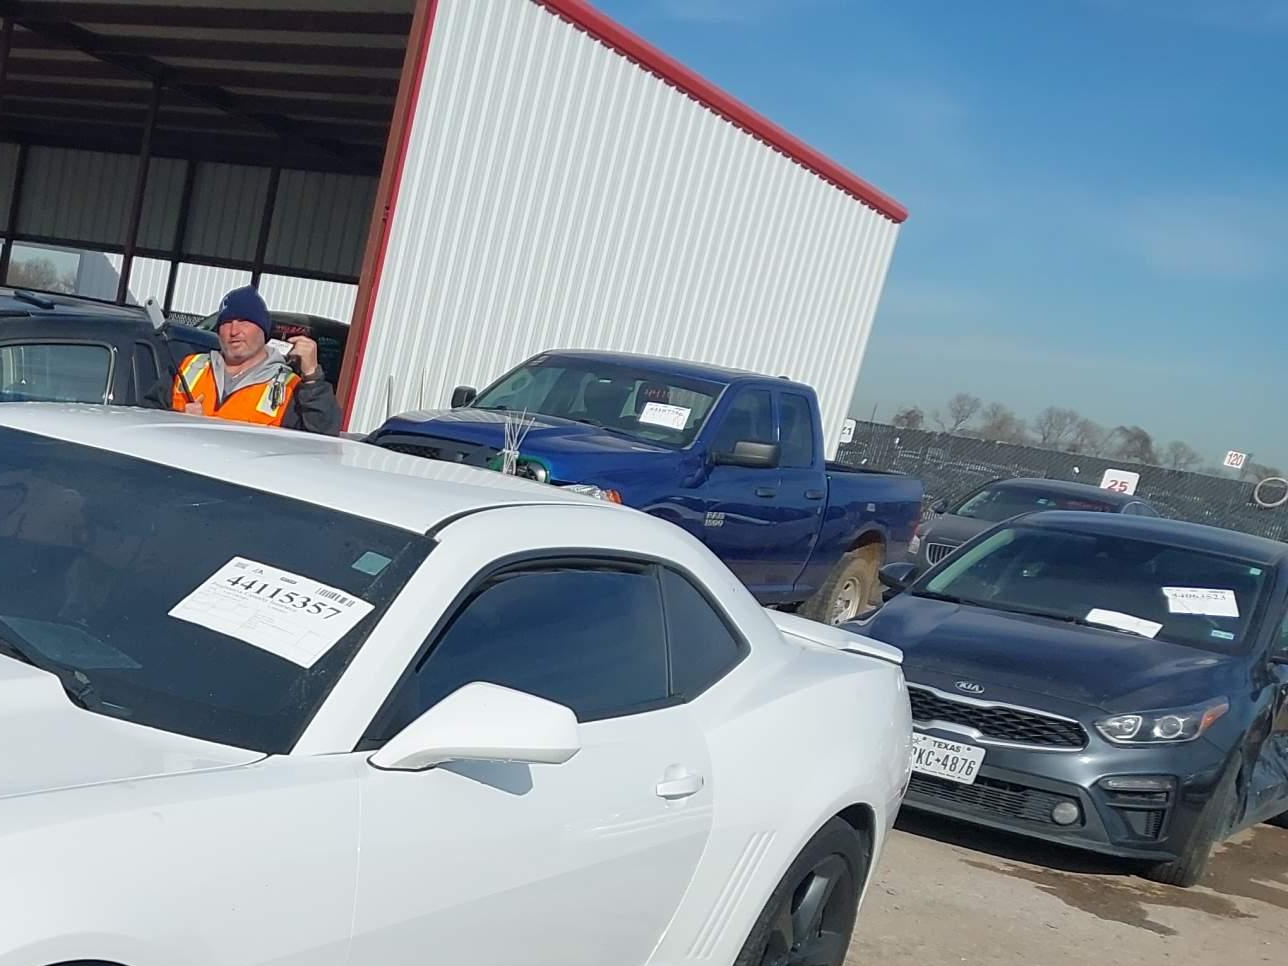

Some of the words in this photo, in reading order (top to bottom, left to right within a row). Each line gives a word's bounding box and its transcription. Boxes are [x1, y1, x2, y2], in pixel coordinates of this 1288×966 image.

[1228, 454, 1243, 466] 120
[1106, 479, 1129, 493] 25
[226, 575, 342, 620] 44115357
[959, 682, 980, 692] KIA
[932, 740, 962, 753] TEXAS
